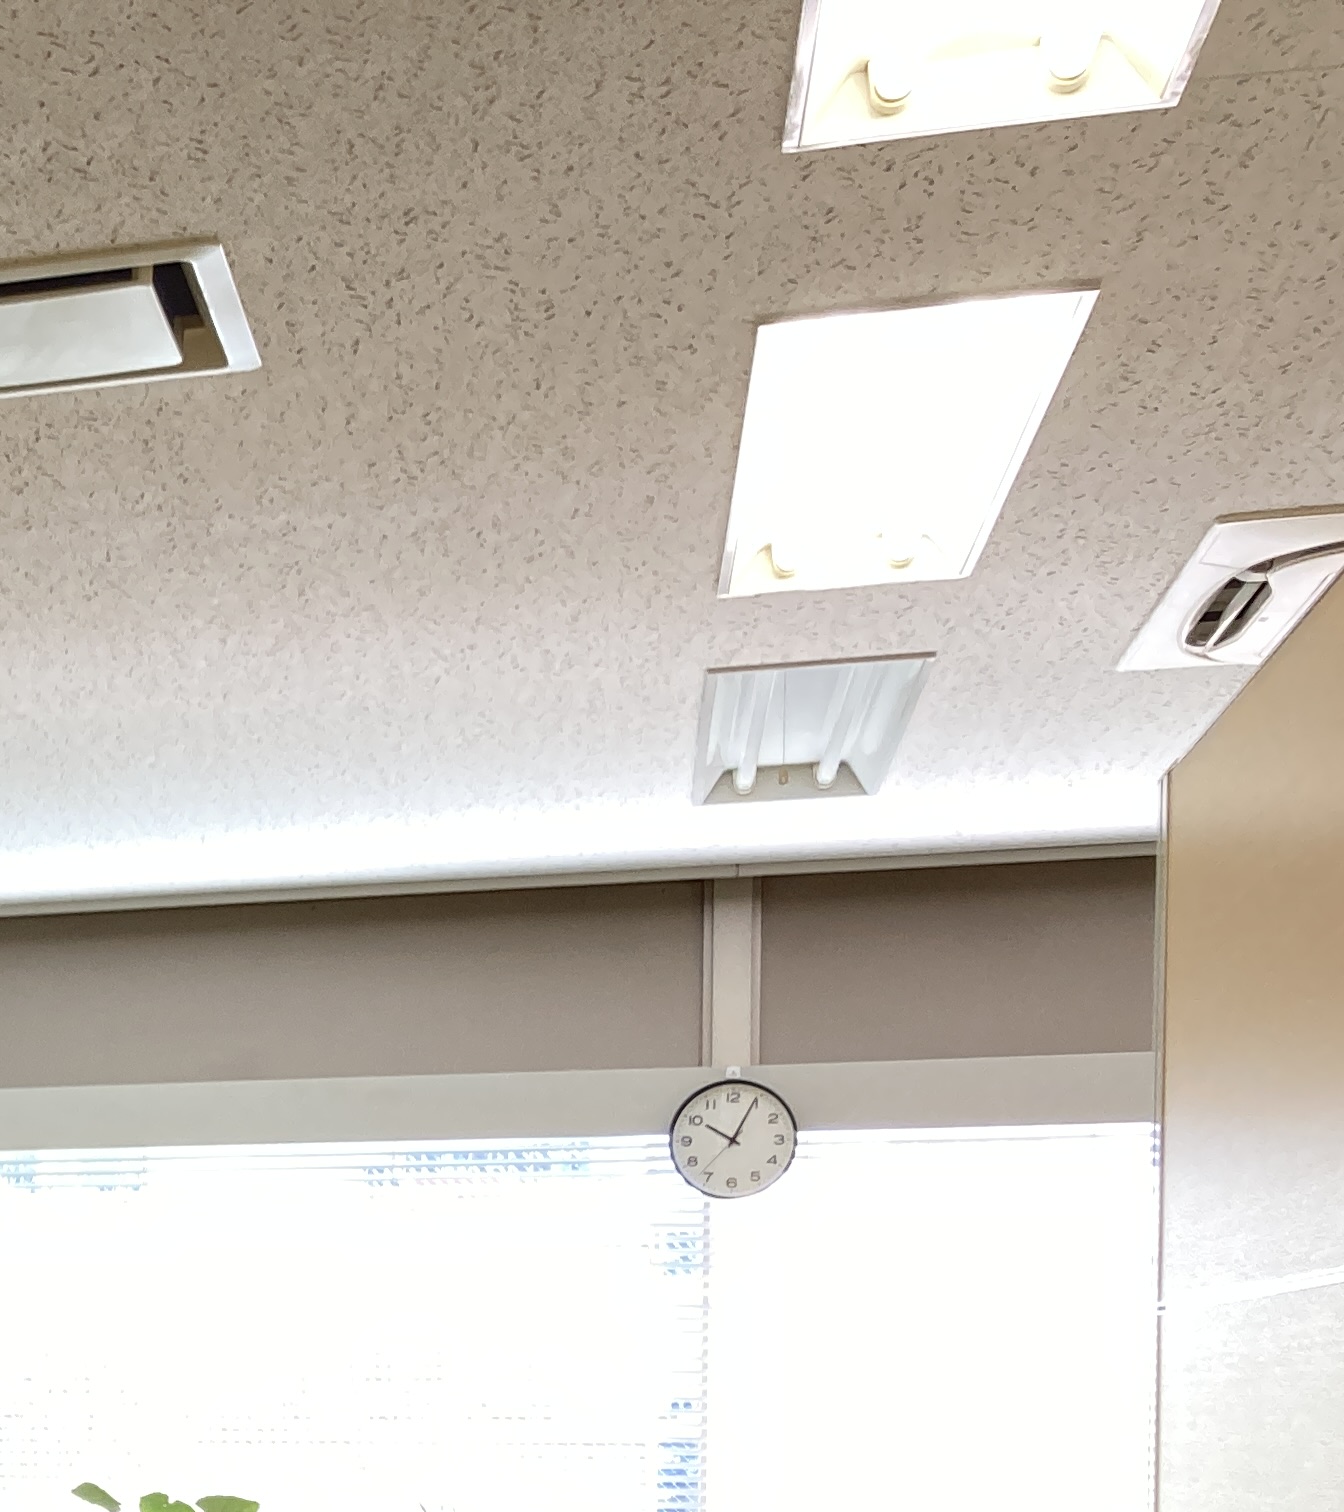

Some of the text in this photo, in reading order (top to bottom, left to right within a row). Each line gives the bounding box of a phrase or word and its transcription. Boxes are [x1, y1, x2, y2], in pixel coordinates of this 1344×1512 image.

[726, 1093, 740, 1103] 12
[705, 1100, 716, 1110] 11
[688, 1115, 703, 1126] 10
[768, 1113, 779, 1124] 2
[681, 1136, 692, 1147] 9
[774, 1134, 785, 1145] 3
[687, 1156, 698, 1167] 8
[766, 1155, 777, 1164] 4
[703, 1172, 714, 1183] 7
[750, 1171, 761, 1182] 5
[726, 1177, 737, 1188] 6
